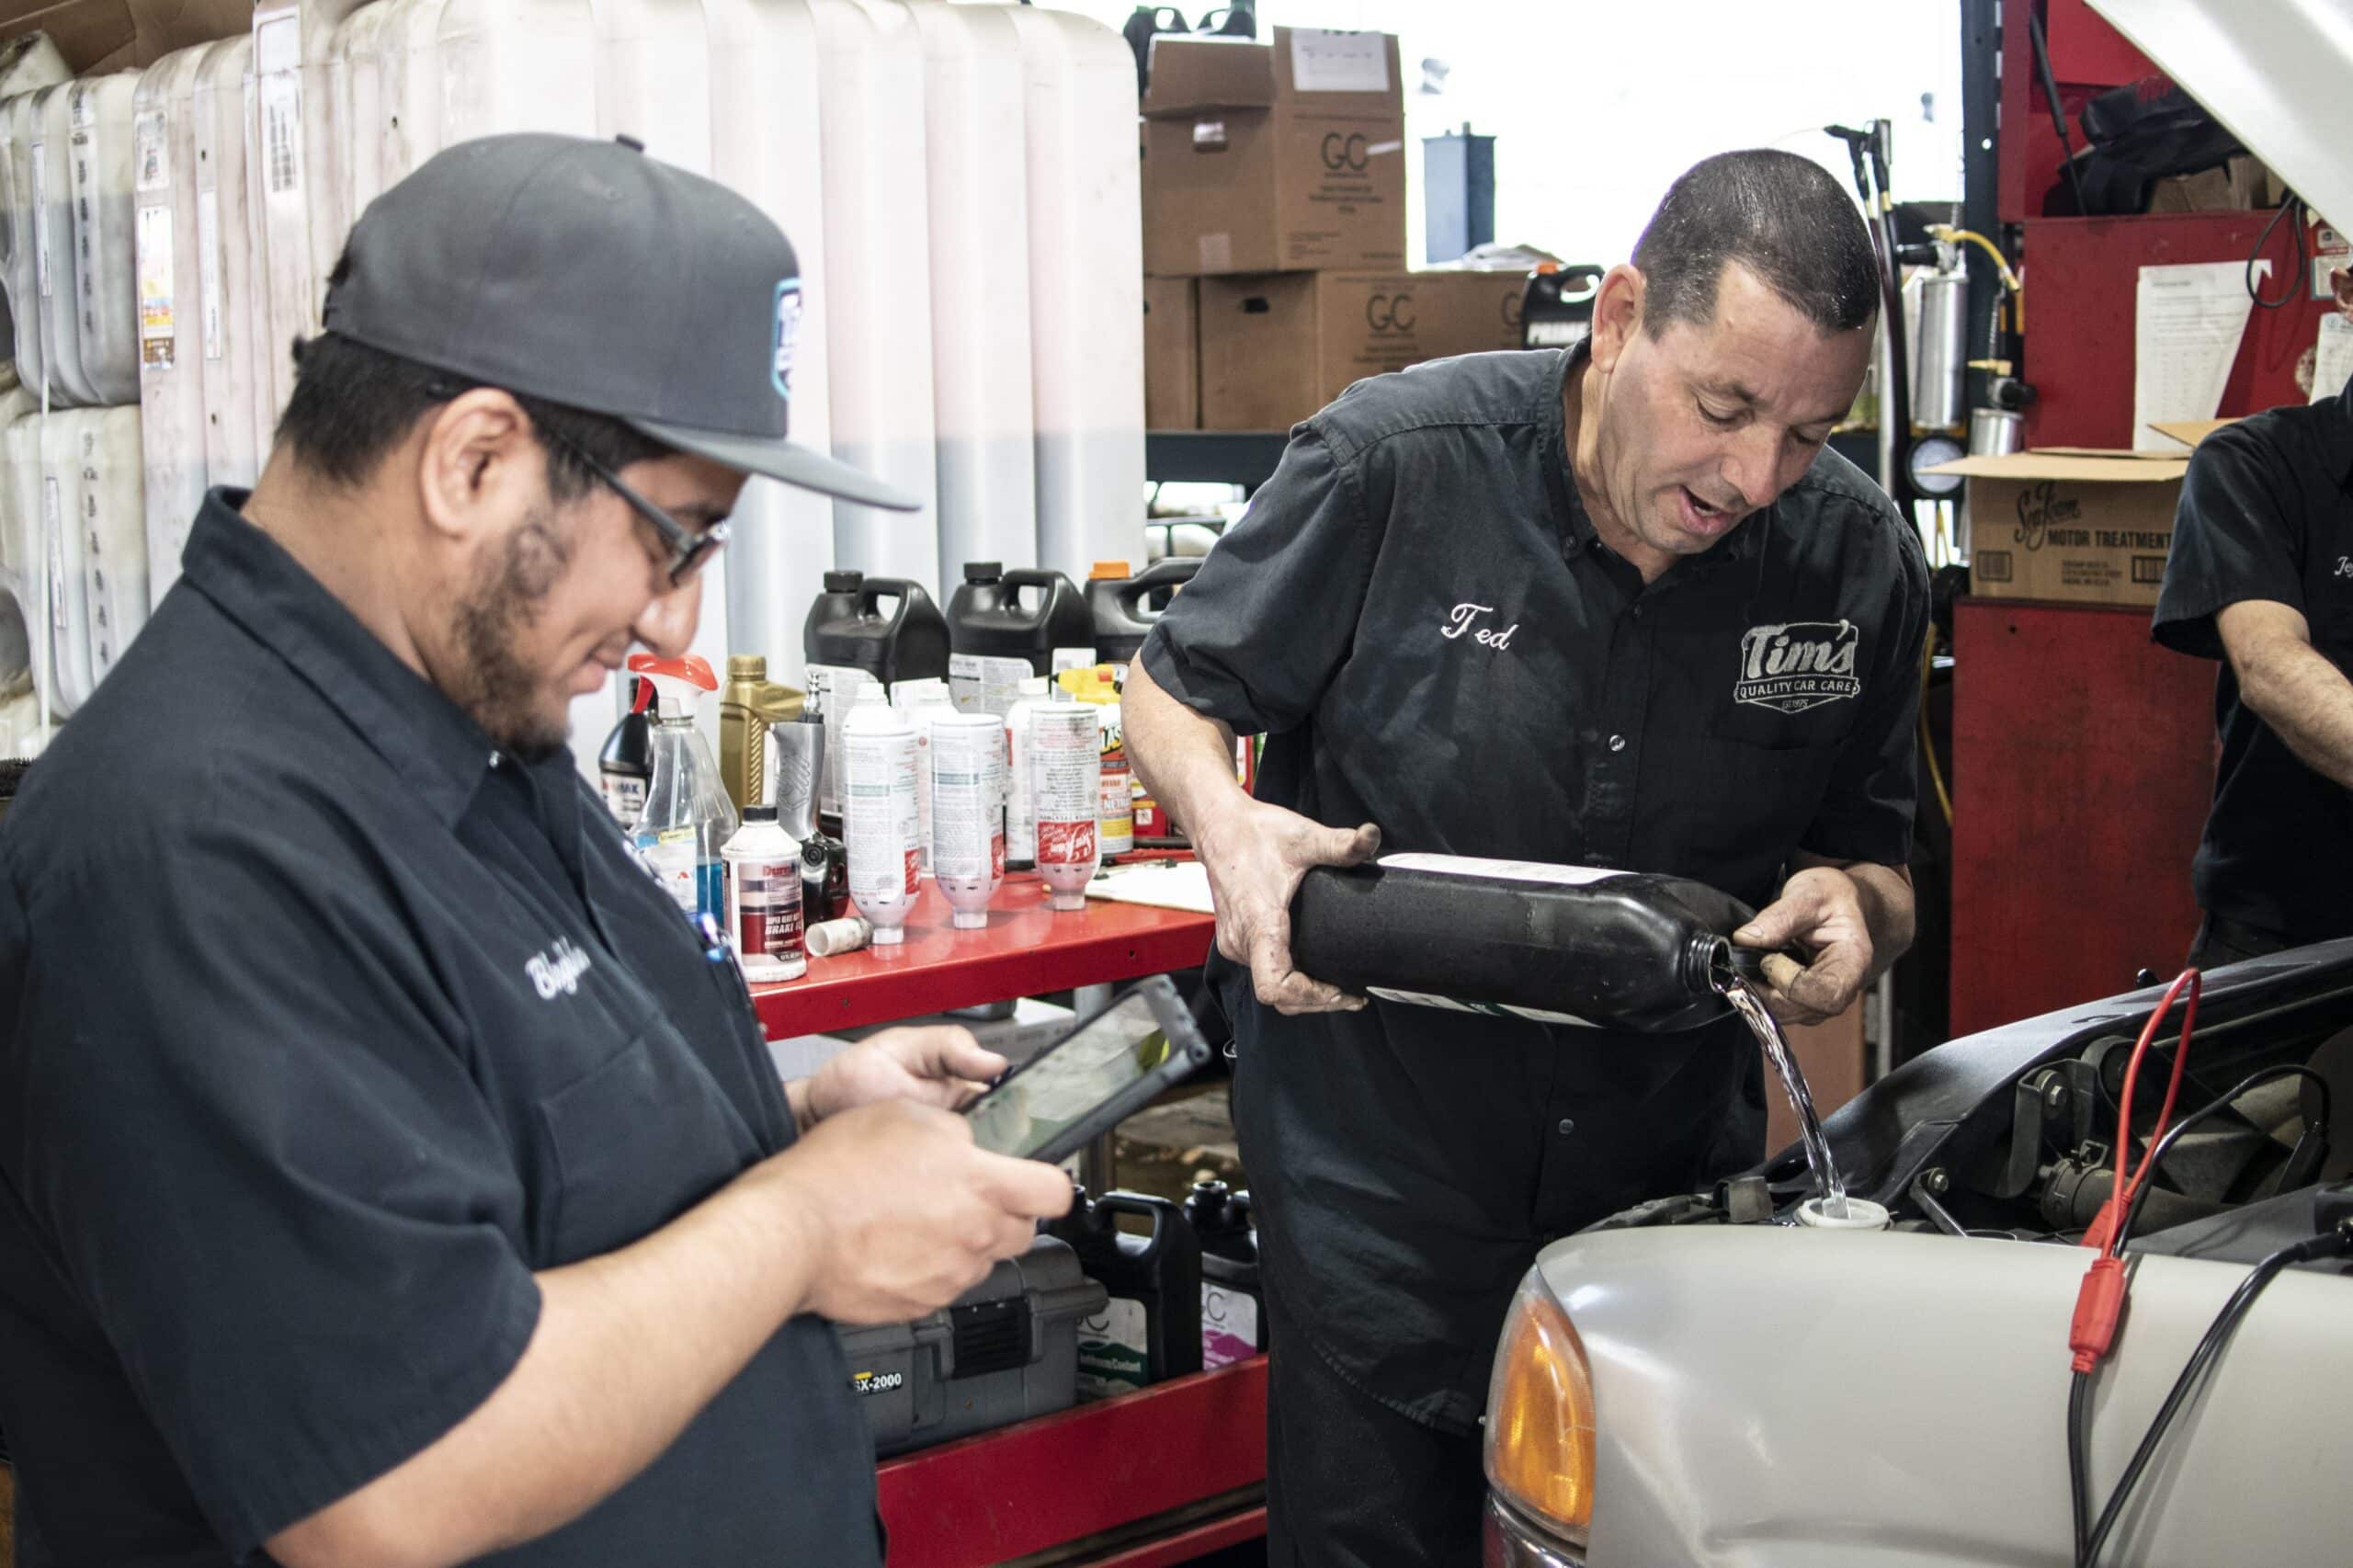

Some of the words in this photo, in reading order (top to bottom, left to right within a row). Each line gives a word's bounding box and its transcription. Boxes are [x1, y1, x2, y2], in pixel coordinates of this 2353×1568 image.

[1321, 131, 1370, 171] GC
[1367, 293, 1416, 332] GC
[2048, 528, 2090, 547] MOTOR
[2096, 530, 2172, 549] TREATMENT
[1440, 603, 1520, 651] Ted
[1742, 619, 1857, 679] Tim's
[1739, 681, 1792, 699] QUALITY
[1793, 680, 1816, 691] CAR
[1821, 680, 1852, 692] CARE
[765, 923, 794, 935] BRAKE
